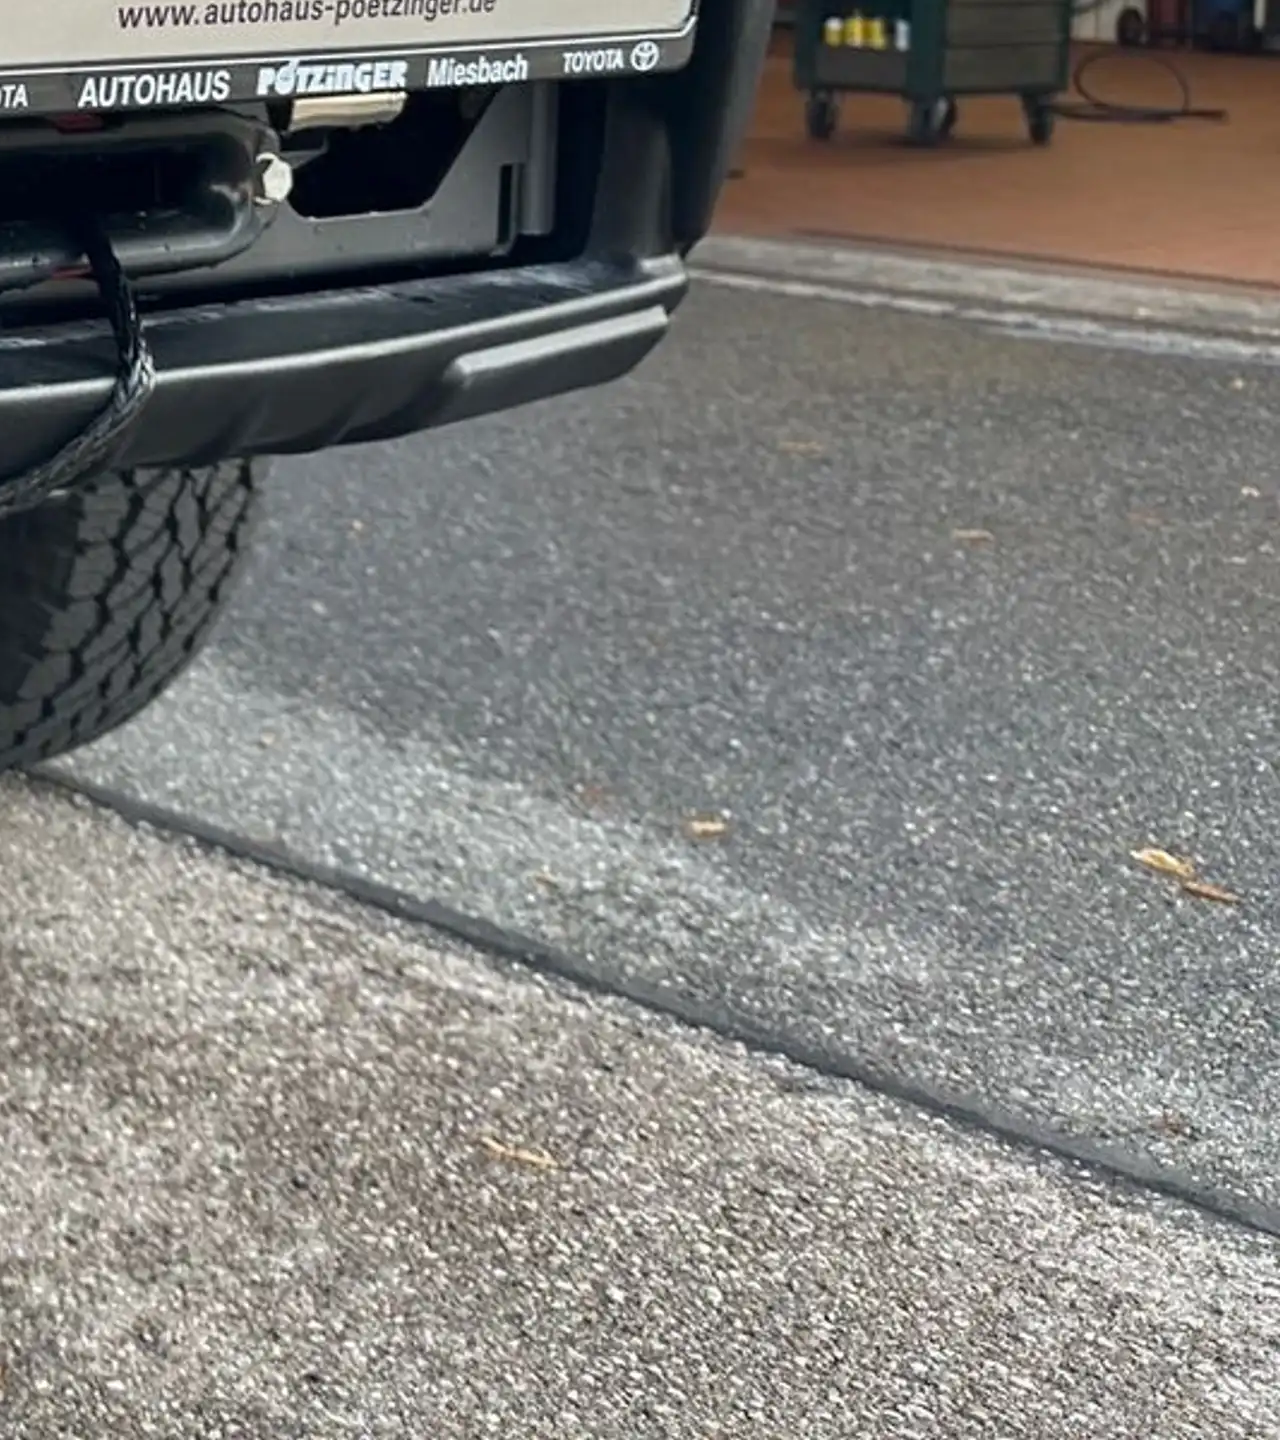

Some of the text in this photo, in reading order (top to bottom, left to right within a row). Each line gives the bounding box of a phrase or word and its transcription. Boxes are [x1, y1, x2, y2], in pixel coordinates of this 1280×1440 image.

[78, 70, 231, 108] AUTOHAUS
[426, 54, 529, 88] Miesbach
[562, 48, 624, 74] TOYOTA
